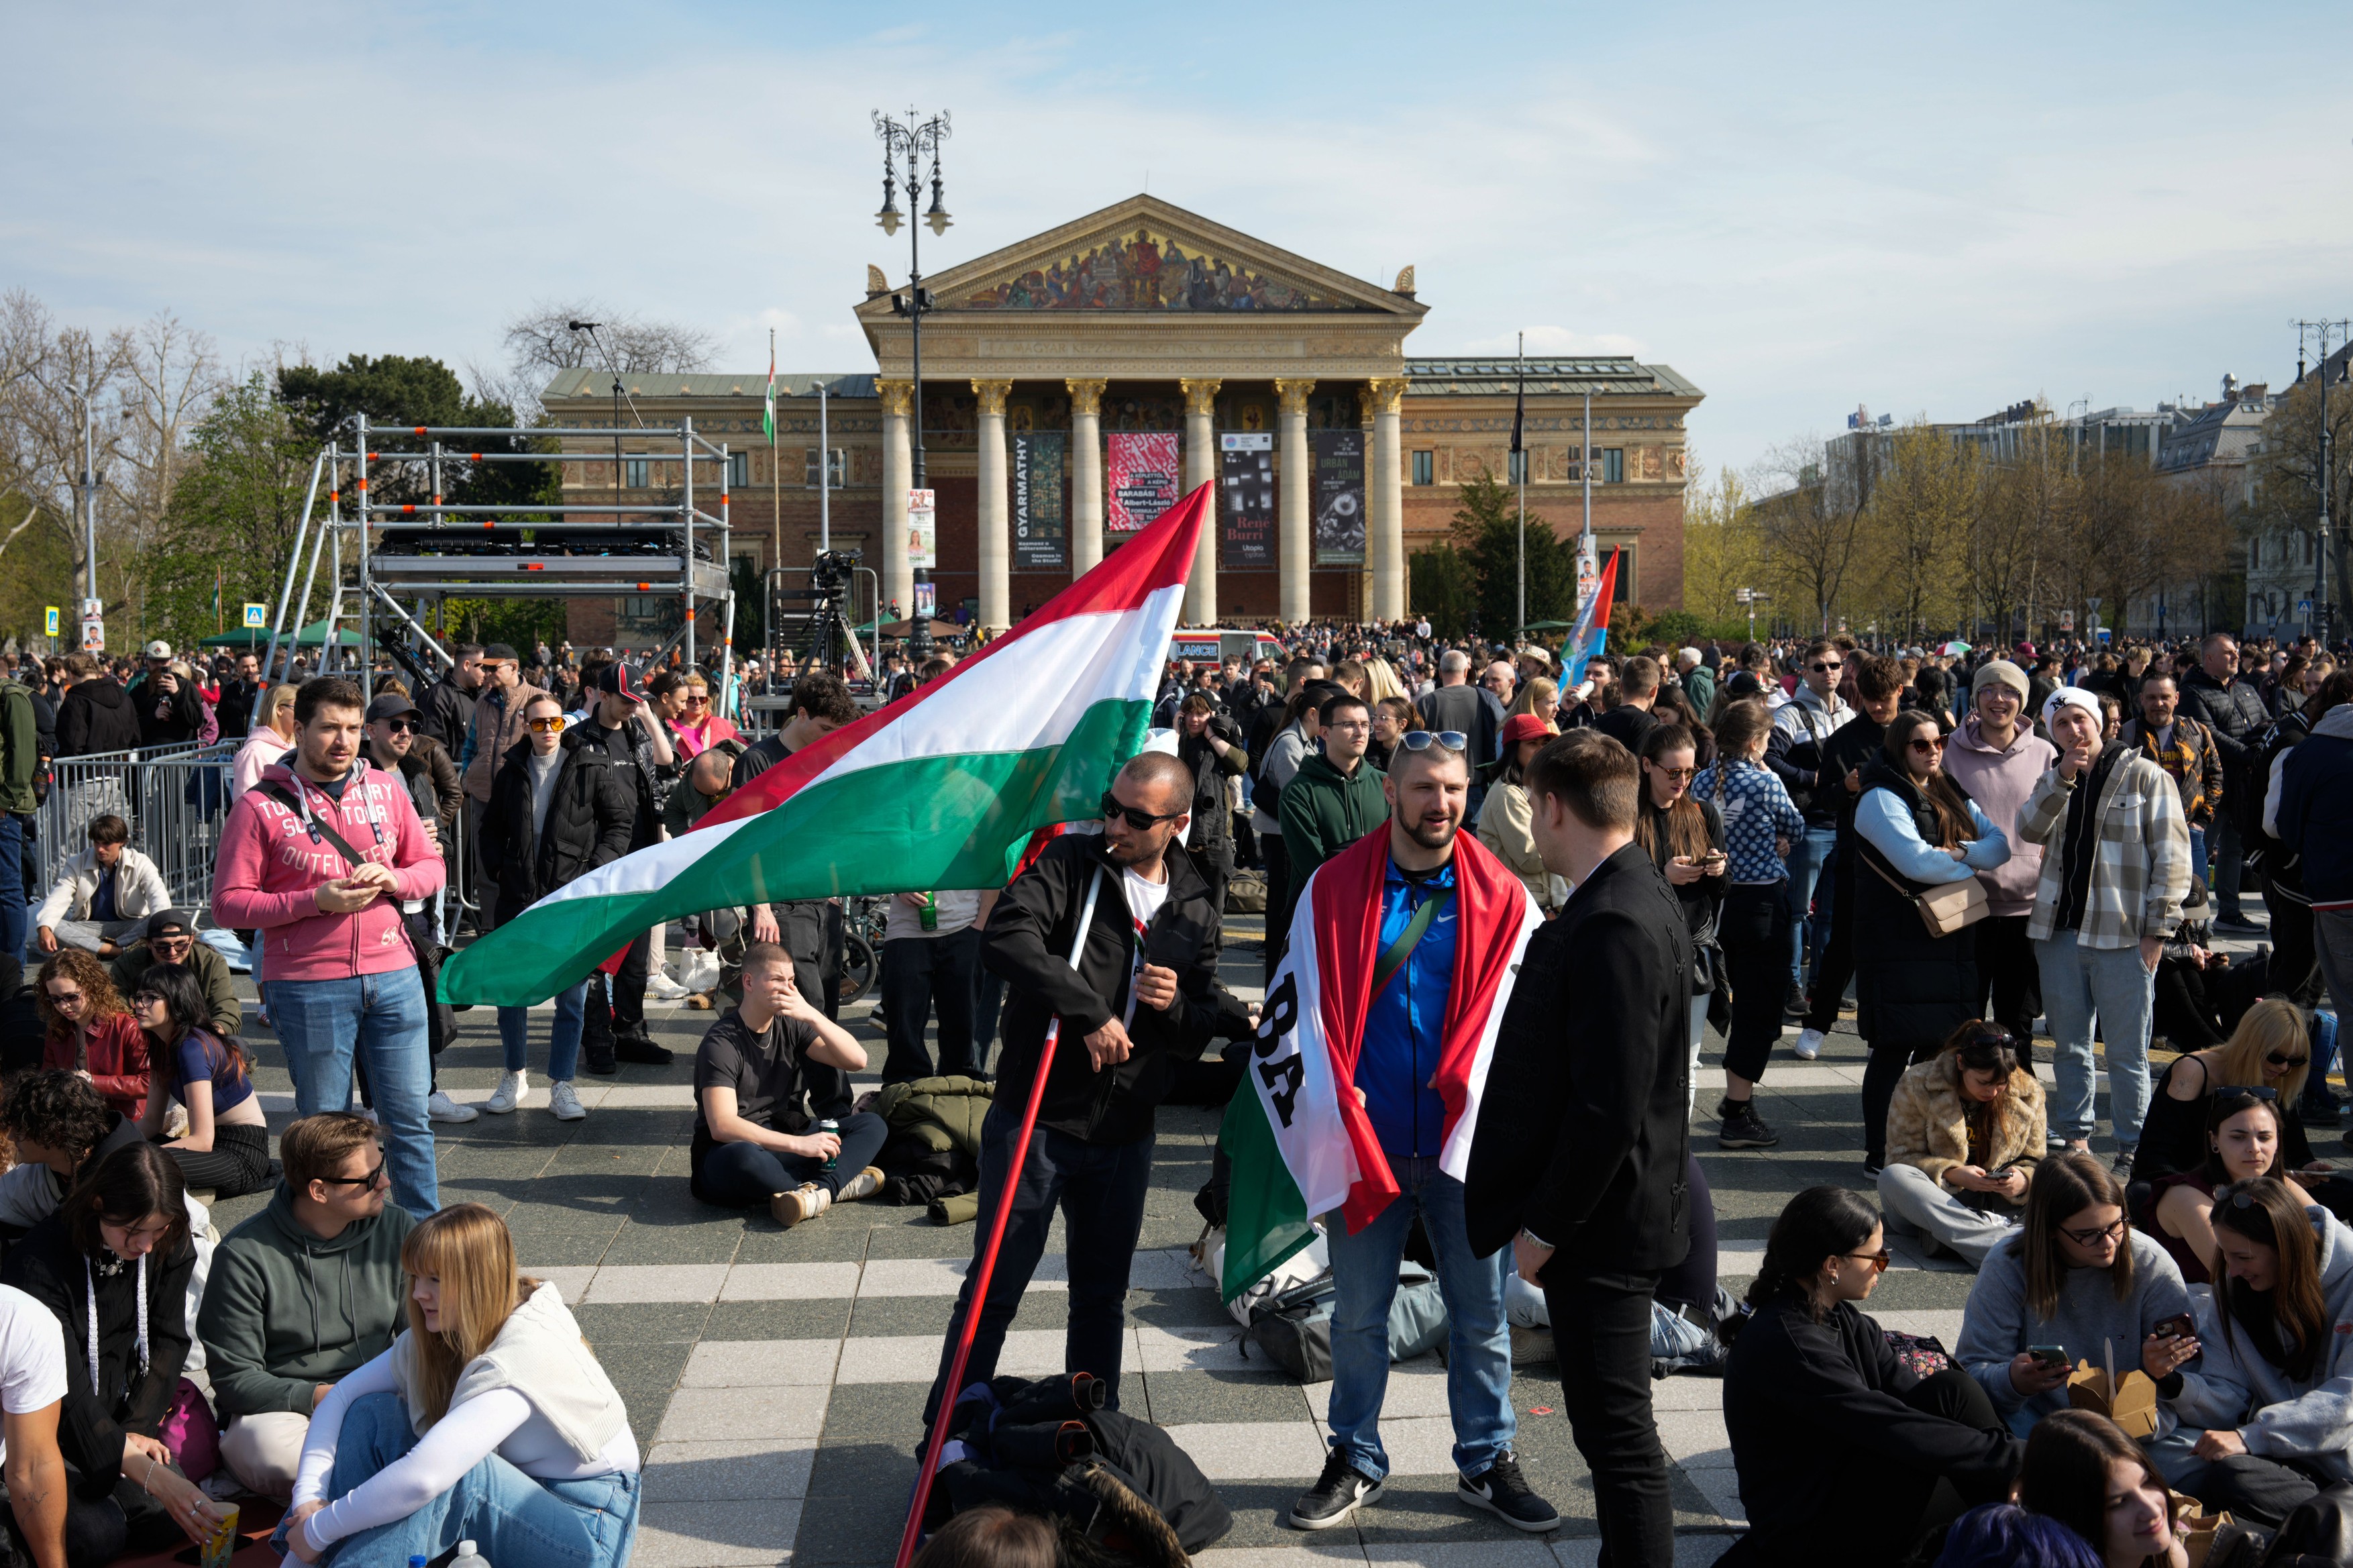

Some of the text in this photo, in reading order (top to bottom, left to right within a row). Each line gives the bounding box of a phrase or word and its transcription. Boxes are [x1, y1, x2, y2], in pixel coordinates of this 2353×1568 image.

[1013, 343, 1066, 354] MAGYAR
[1016, 438, 1028, 537] GYARMATHY
[1237, 516, 1270, 529] René
[1227, 528, 1263, 540] Burri
[342, 805, 388, 825] TOR
[380, 926, 399, 945] 68
[1254, 933, 1305, 1129] BA
